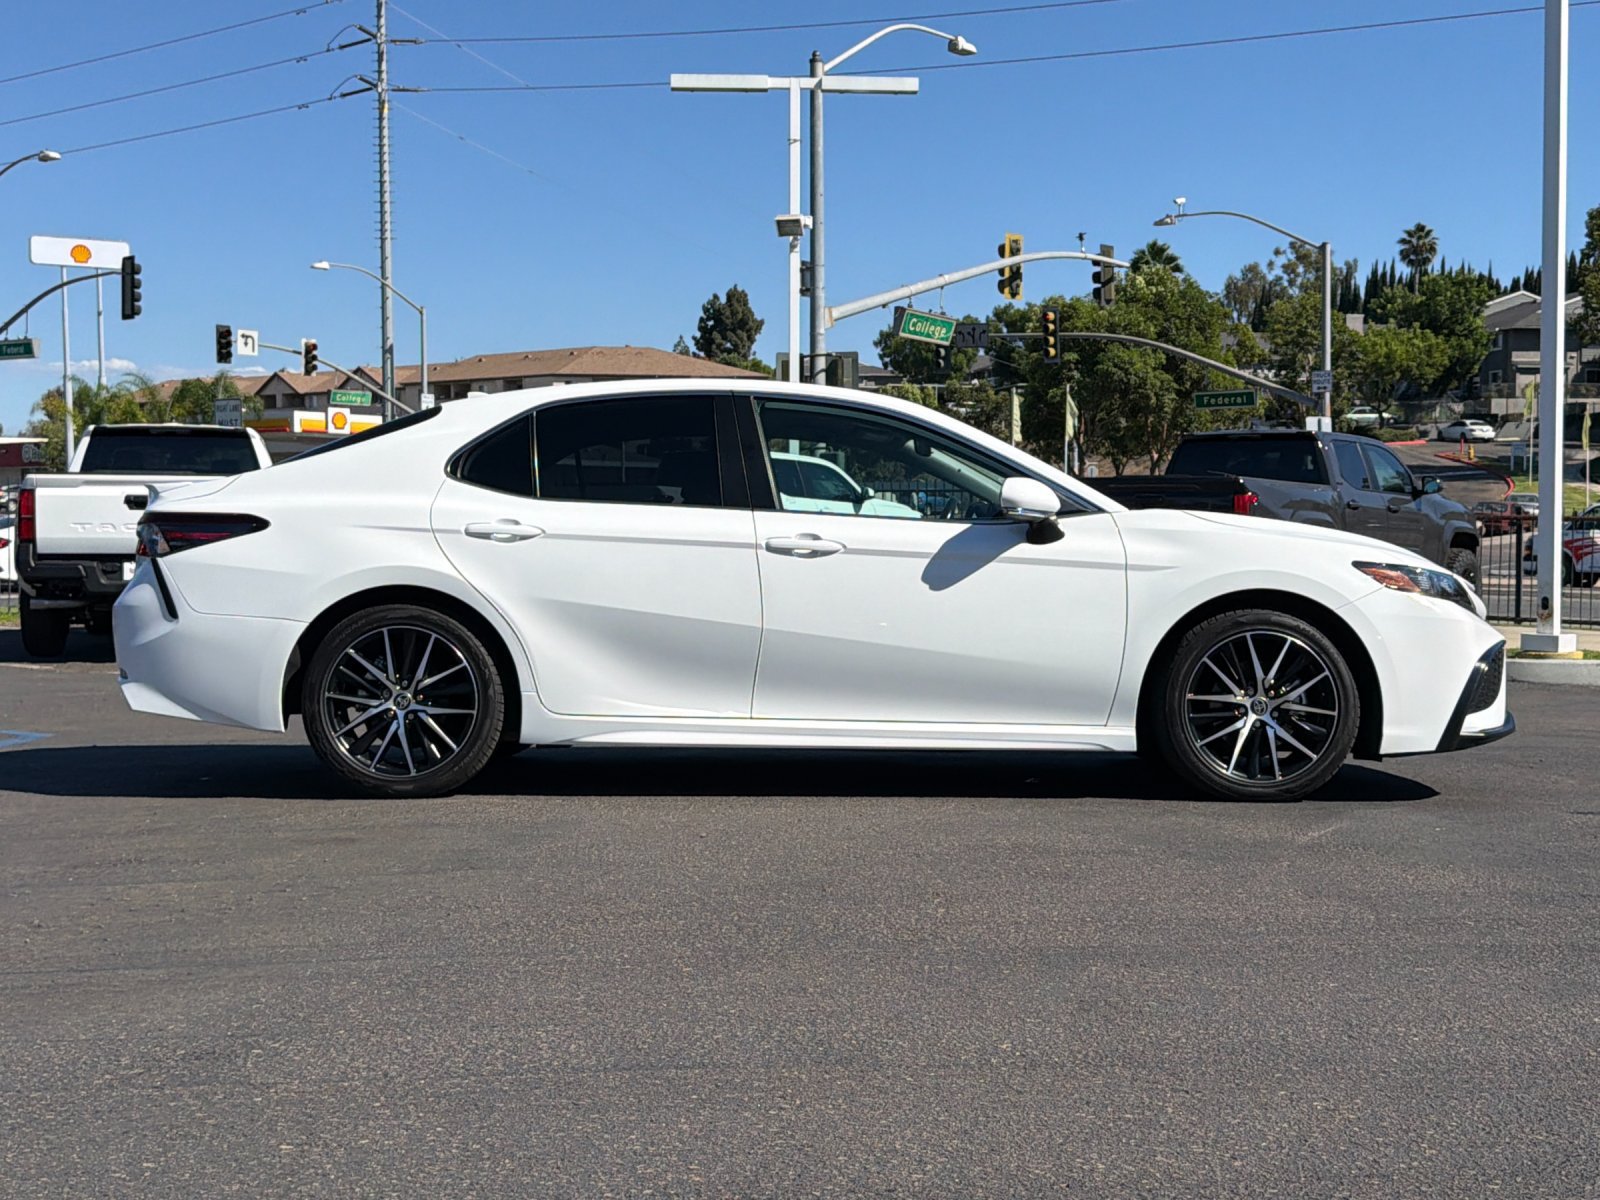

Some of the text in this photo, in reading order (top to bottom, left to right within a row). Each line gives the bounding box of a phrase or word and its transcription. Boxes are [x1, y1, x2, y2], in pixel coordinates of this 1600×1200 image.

[909, 318, 947, 339] College
[336, 393, 367, 405] College
[1203, 395, 1247, 405] Federal
